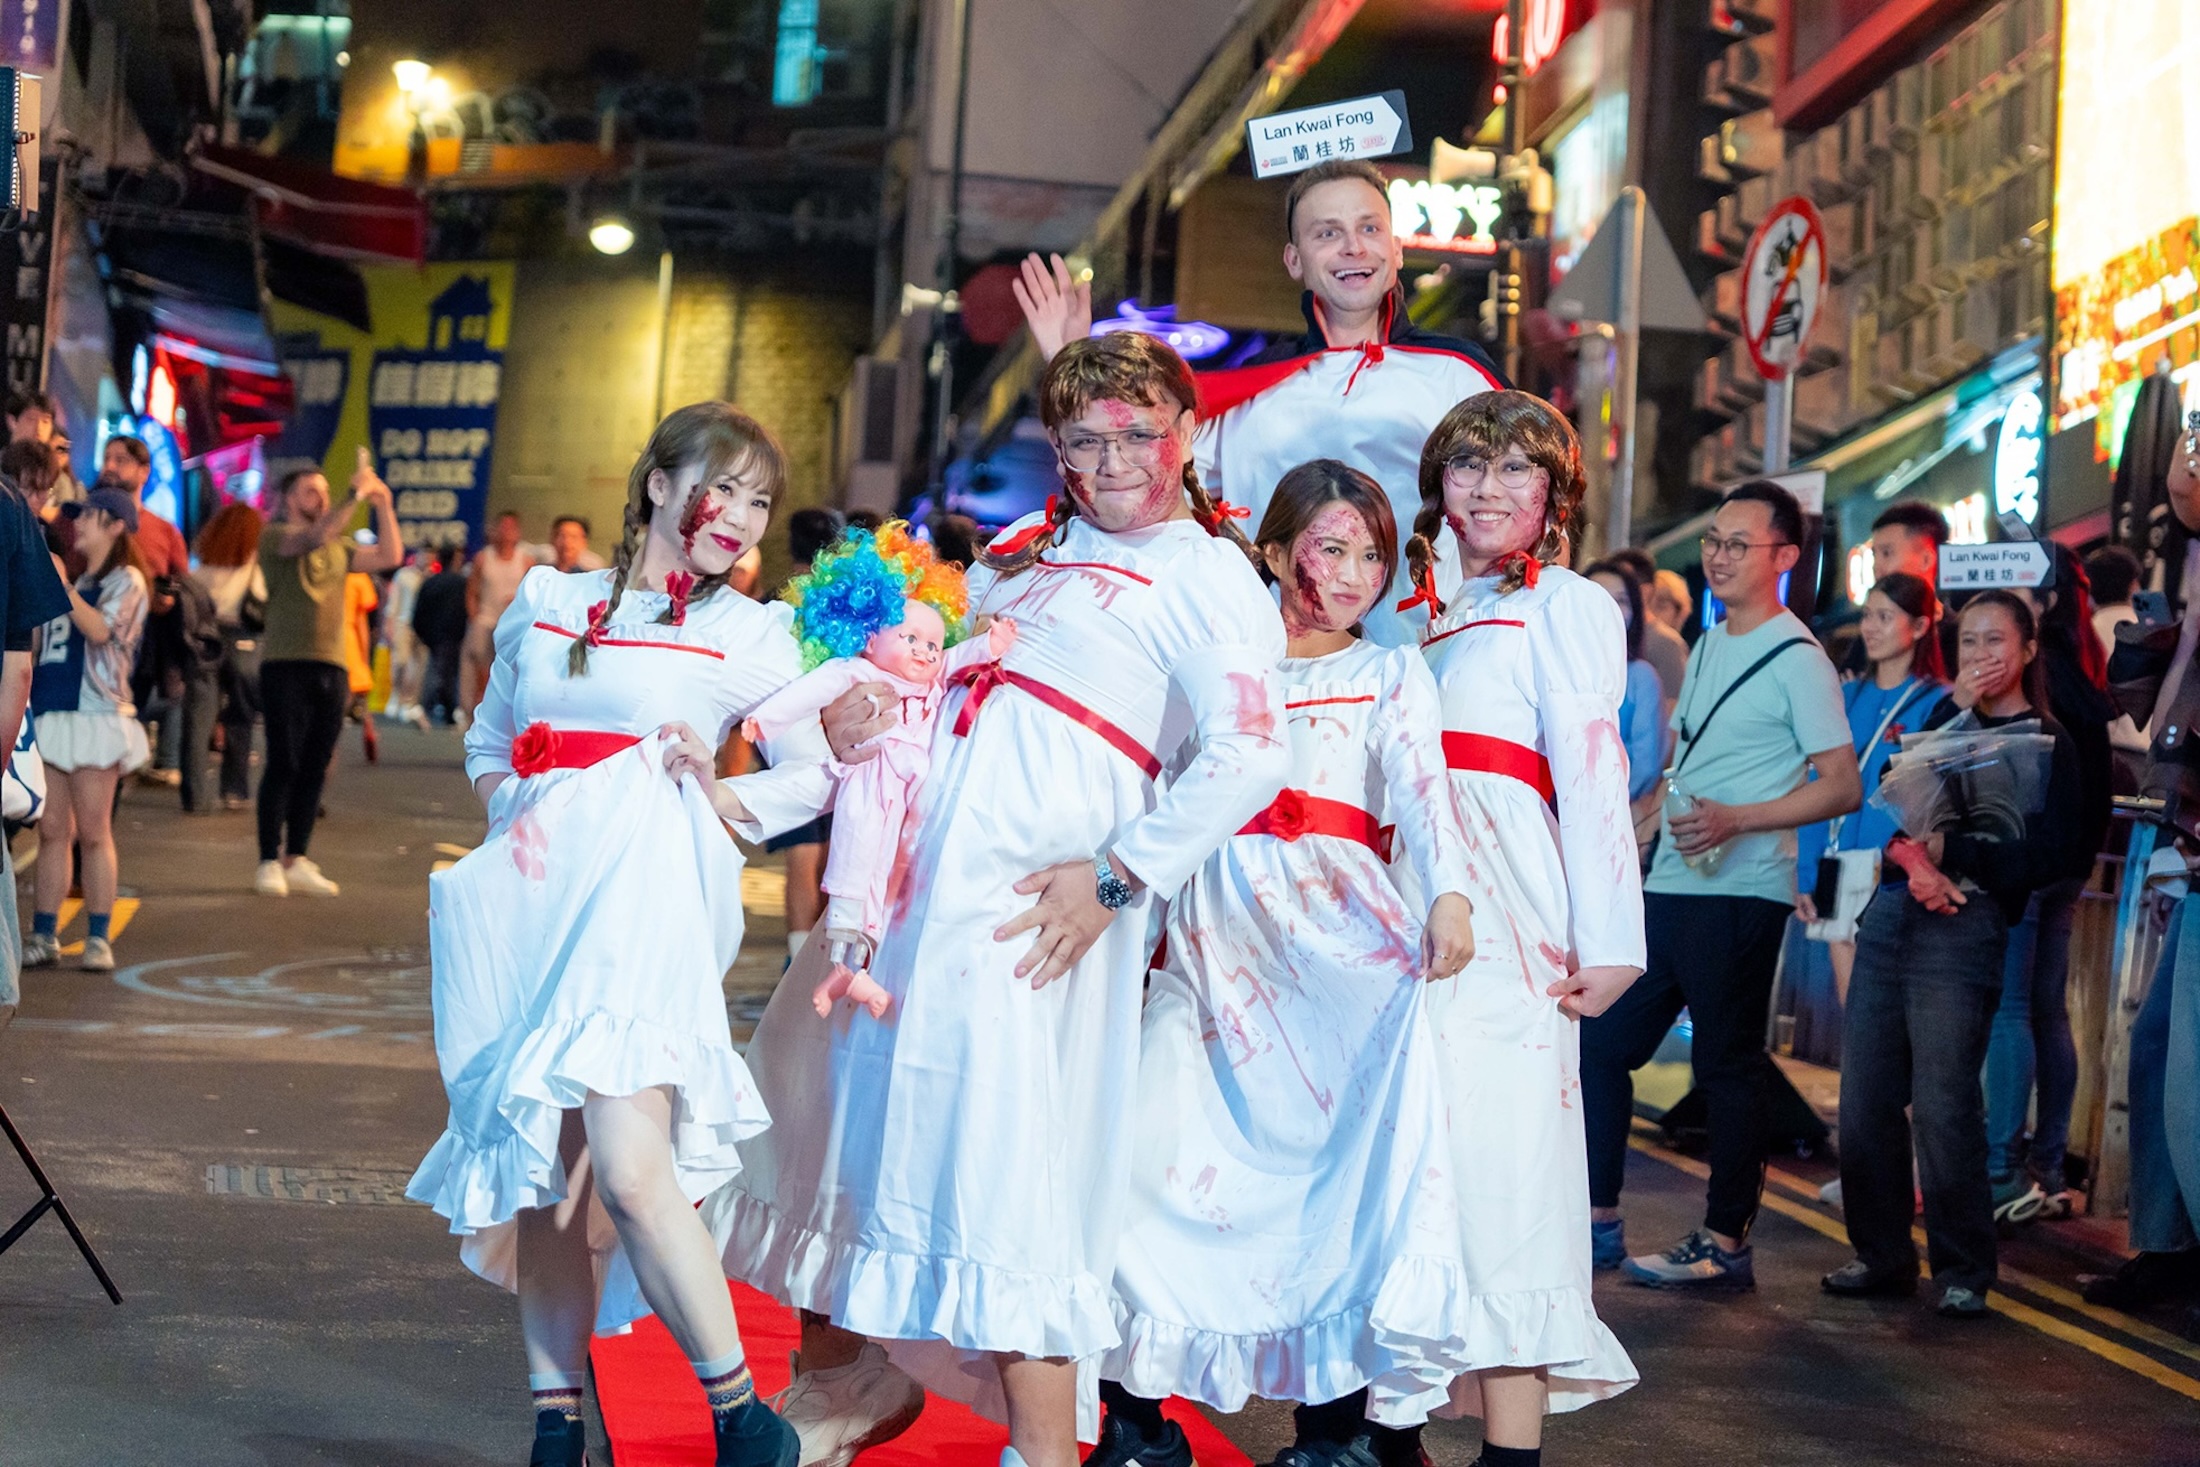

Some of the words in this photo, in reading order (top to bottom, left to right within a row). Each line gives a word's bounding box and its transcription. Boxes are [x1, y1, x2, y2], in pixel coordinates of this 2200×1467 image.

[1264, 125, 1292, 141] Lan
[1295, 115, 1332, 135] Kwai
[1336, 110, 1374, 127] Fong
[1292, 136, 1355, 163] 蘭桂坊
[381, 428, 423, 457] DO
[426, 428, 489, 456] NOT
[386, 459, 475, 489] DRINK
[398, 490, 458, 518] AND
[1949, 552, 1969, 562] Lan
[1972, 550, 1999, 561] Kwai
[2002, 549, 2030, 562] Fong
